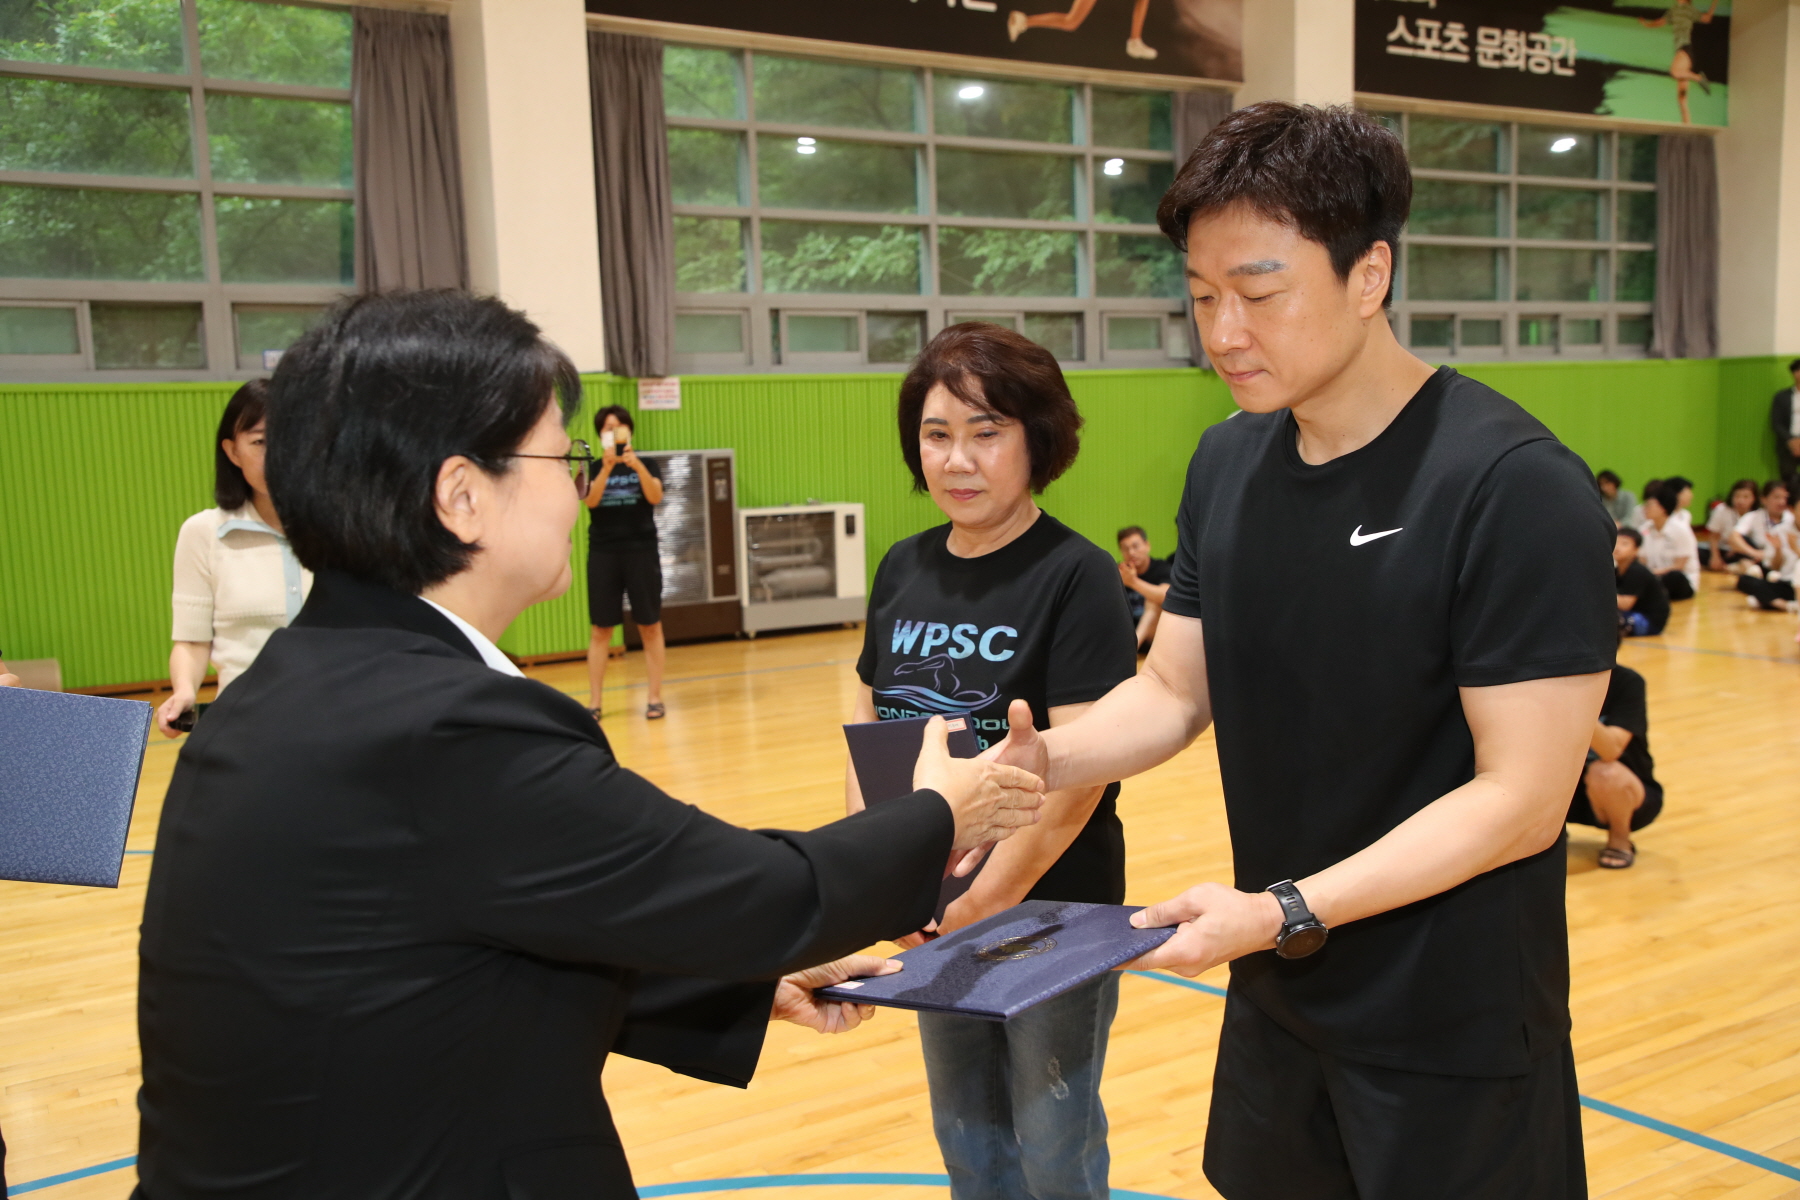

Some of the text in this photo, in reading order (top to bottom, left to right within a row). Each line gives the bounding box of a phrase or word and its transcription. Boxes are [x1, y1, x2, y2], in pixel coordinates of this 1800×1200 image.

[1386, 15, 1577, 76] 스포츠 문화공간
[891, 619, 1018, 662] WPSC
